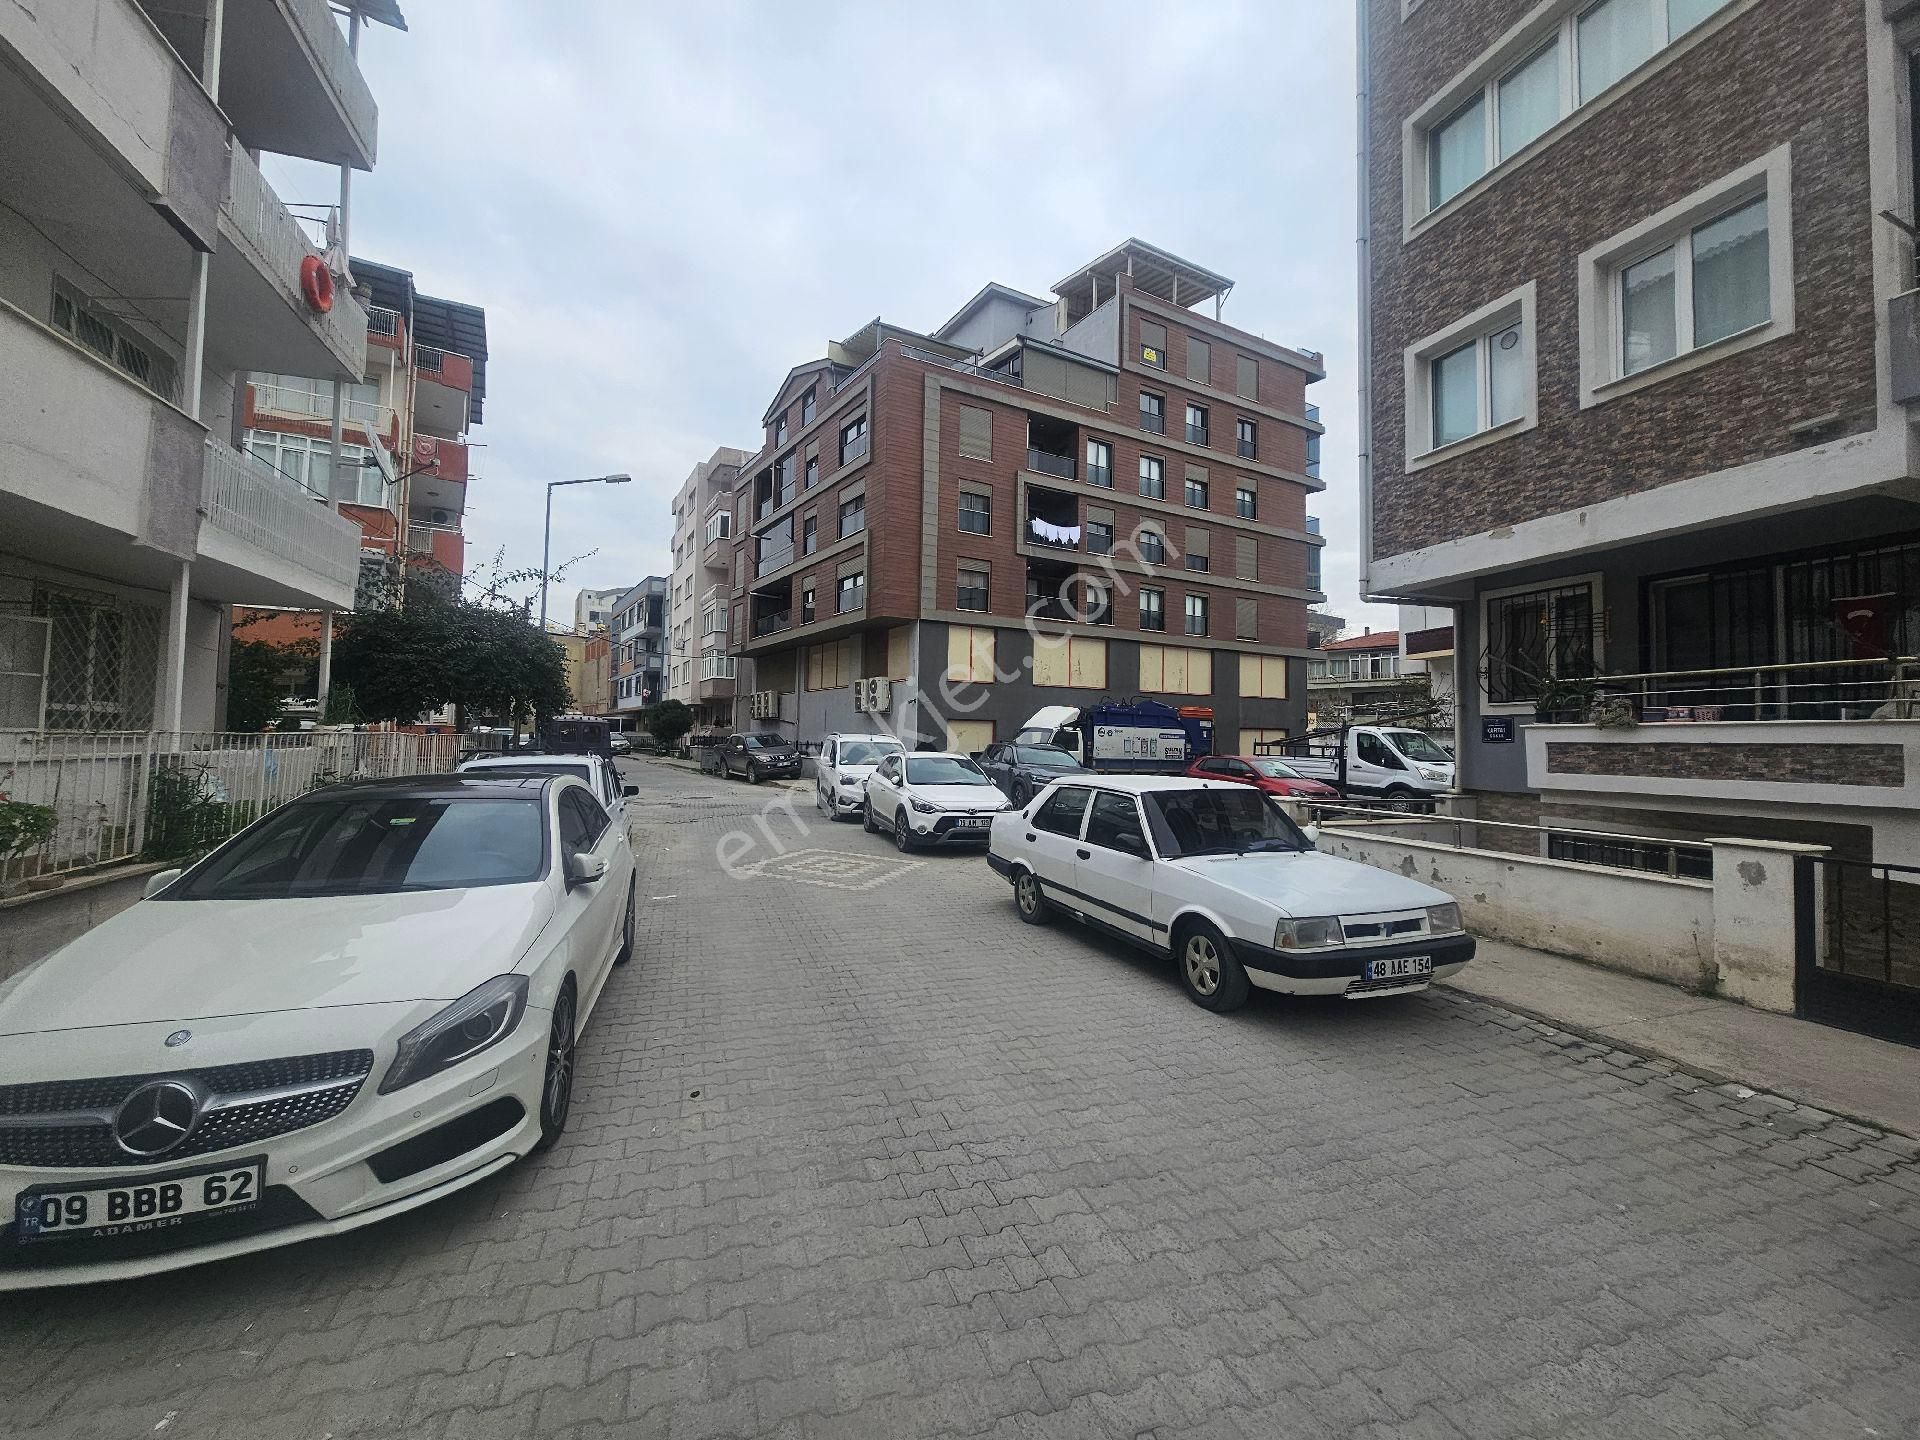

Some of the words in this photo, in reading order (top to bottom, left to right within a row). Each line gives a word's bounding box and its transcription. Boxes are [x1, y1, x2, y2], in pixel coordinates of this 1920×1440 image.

[1374, 962, 1386, 977] 48
[1391, 960, 1409, 975] AAE
[1413, 958, 1430, 973] 154
[40, 1195, 88, 1228] 09
[107, 1183, 183, 1222] BBB
[203, 1170, 253, 1206] 62
[23, 1216, 39, 1227] TR
[93, 1216, 183, 1237] ADAMER
